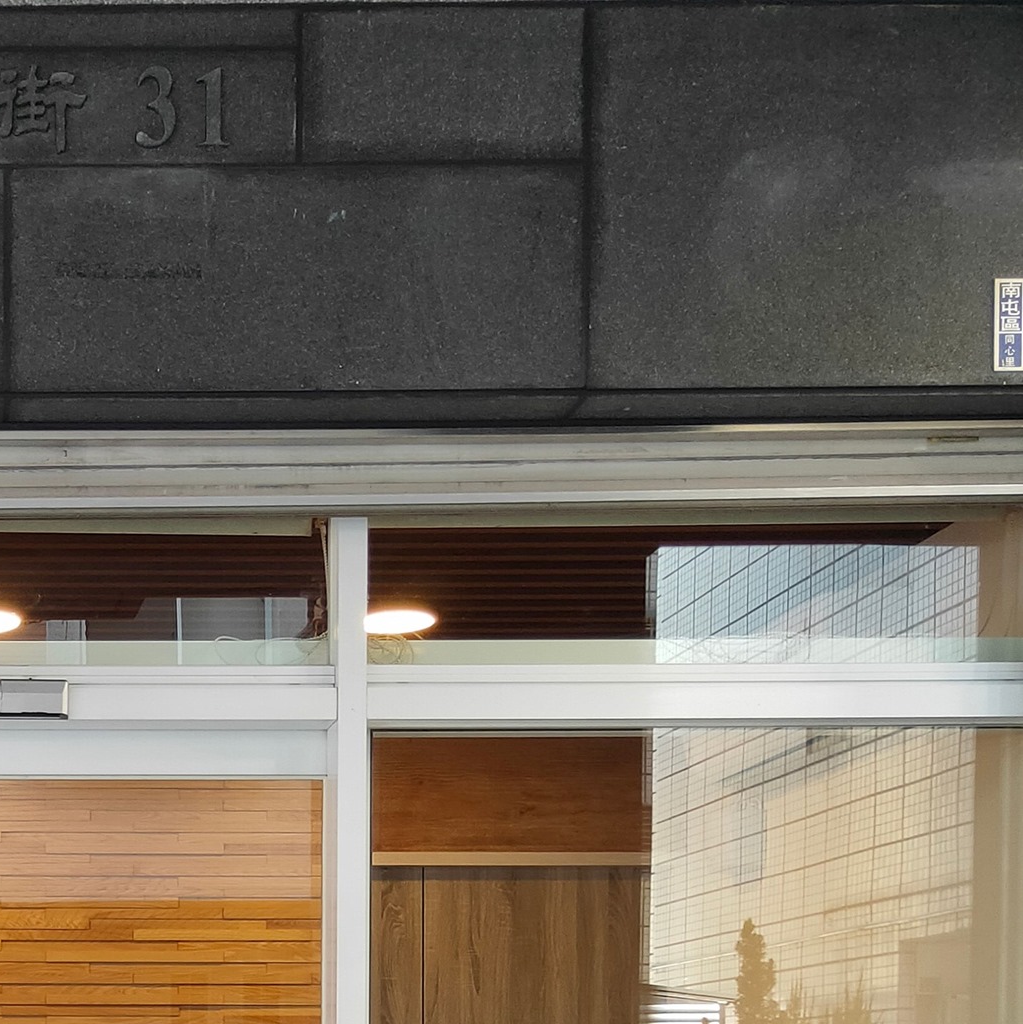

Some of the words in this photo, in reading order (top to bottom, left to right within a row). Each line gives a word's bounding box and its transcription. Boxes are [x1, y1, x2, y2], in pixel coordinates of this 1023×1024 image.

[135, 65, 229, 148] 31
[1000, 281, 1022, 332] 南屯區
